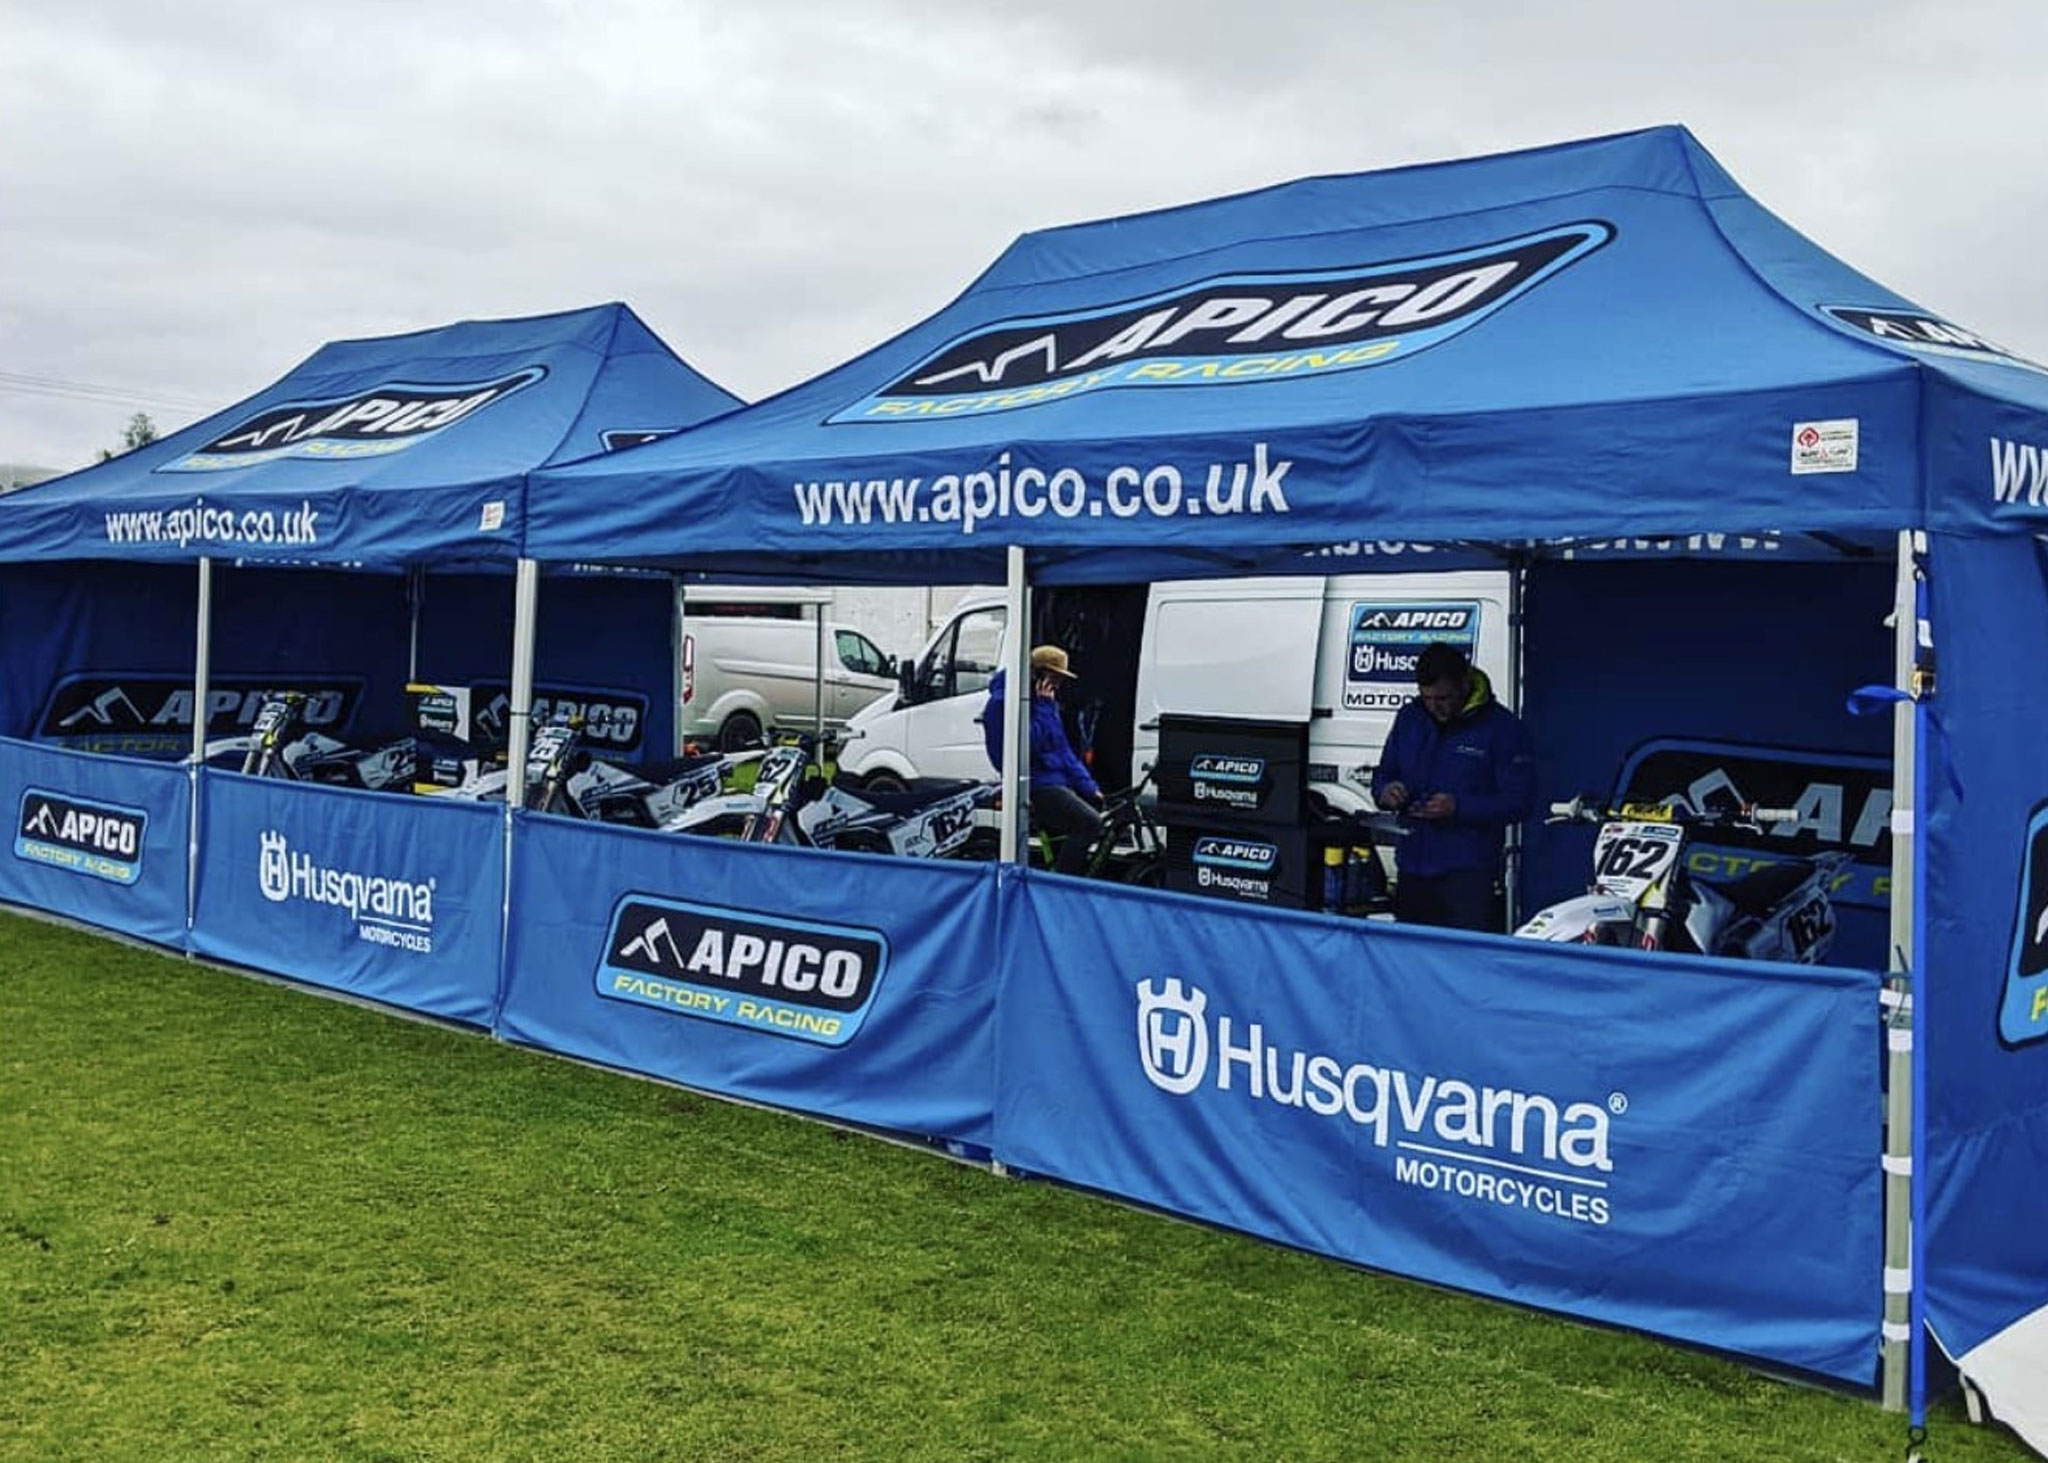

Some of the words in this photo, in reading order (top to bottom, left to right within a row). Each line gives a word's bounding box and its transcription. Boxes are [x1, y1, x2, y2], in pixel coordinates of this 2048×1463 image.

[1062, 261, 1517, 370] APICO
[866, 367, 1118, 416] FACTORY
[1127, 342, 1400, 381] RACING
[794, 443, 1293, 534] www.apico.co.uk
[105, 498, 318, 547] www.apico.co.uk
[1392, 612, 1467, 627] APICO
[530, 736, 564, 760] 25
[1215, 760, 1259, 774] APICO
[680, 777, 717, 809] 25
[60, 810, 136, 855] APICO
[928, 804, 972, 845] 162
[1222, 844, 1271, 861] APICO
[1596, 838, 1670, 880] 162
[359, 925, 432, 953] MOTORCYCLES
[688, 928, 863, 999] APICO
[614, 974, 730, 1014] FACTORY
[738, 1002, 840, 1036] RACING
[1396, 1156, 1610, 1225] MOTORCYCLES
